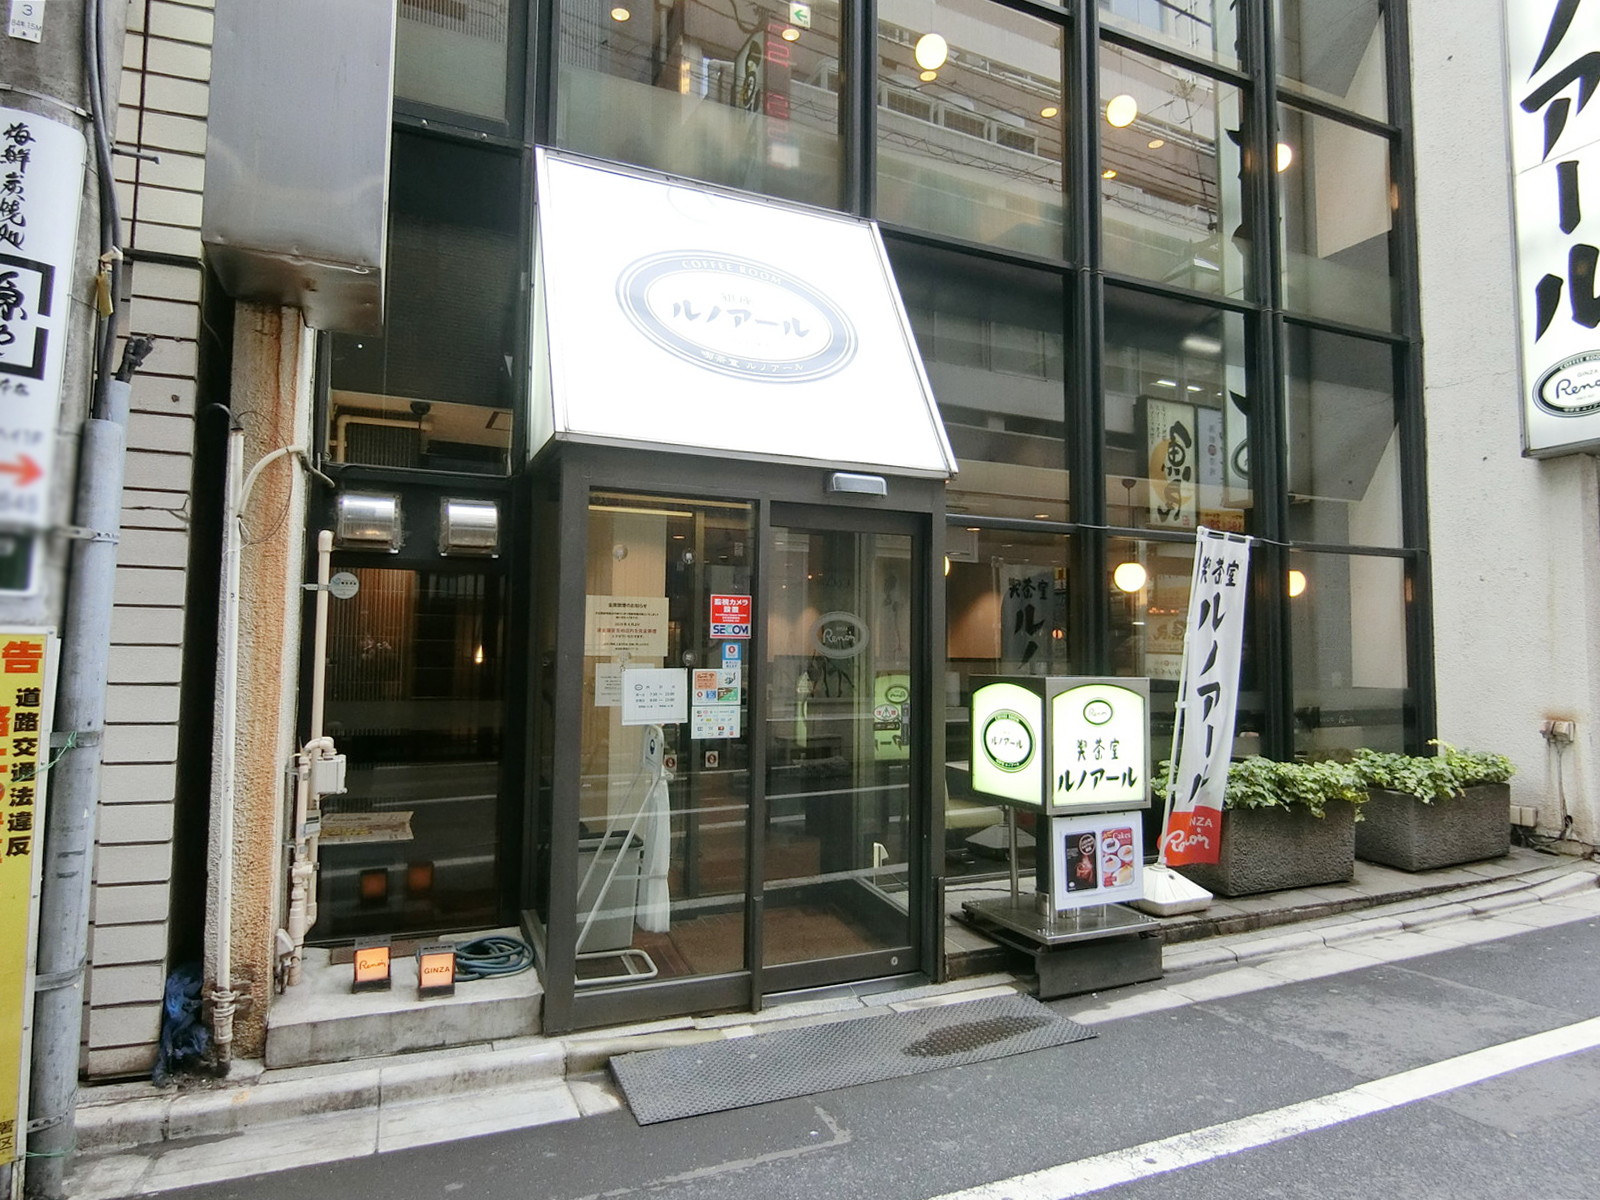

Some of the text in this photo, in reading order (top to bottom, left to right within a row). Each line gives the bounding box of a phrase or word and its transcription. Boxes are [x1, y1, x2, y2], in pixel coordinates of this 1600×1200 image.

[22, 4, 33, 16] 3
[682, 260, 783, 286] COFFEE ROOM
[673, 300, 810, 338] ルノアール
[746, 362, 805, 372] ルノアール
[713, 624, 749, 635] SECOM
[991, 736, 1023, 750] ルノアール
[5, 687, 42, 857] 道路交通法違反
[1058, 766, 1139, 793] ルノアール
[423, 966, 450, 975] GINZA
